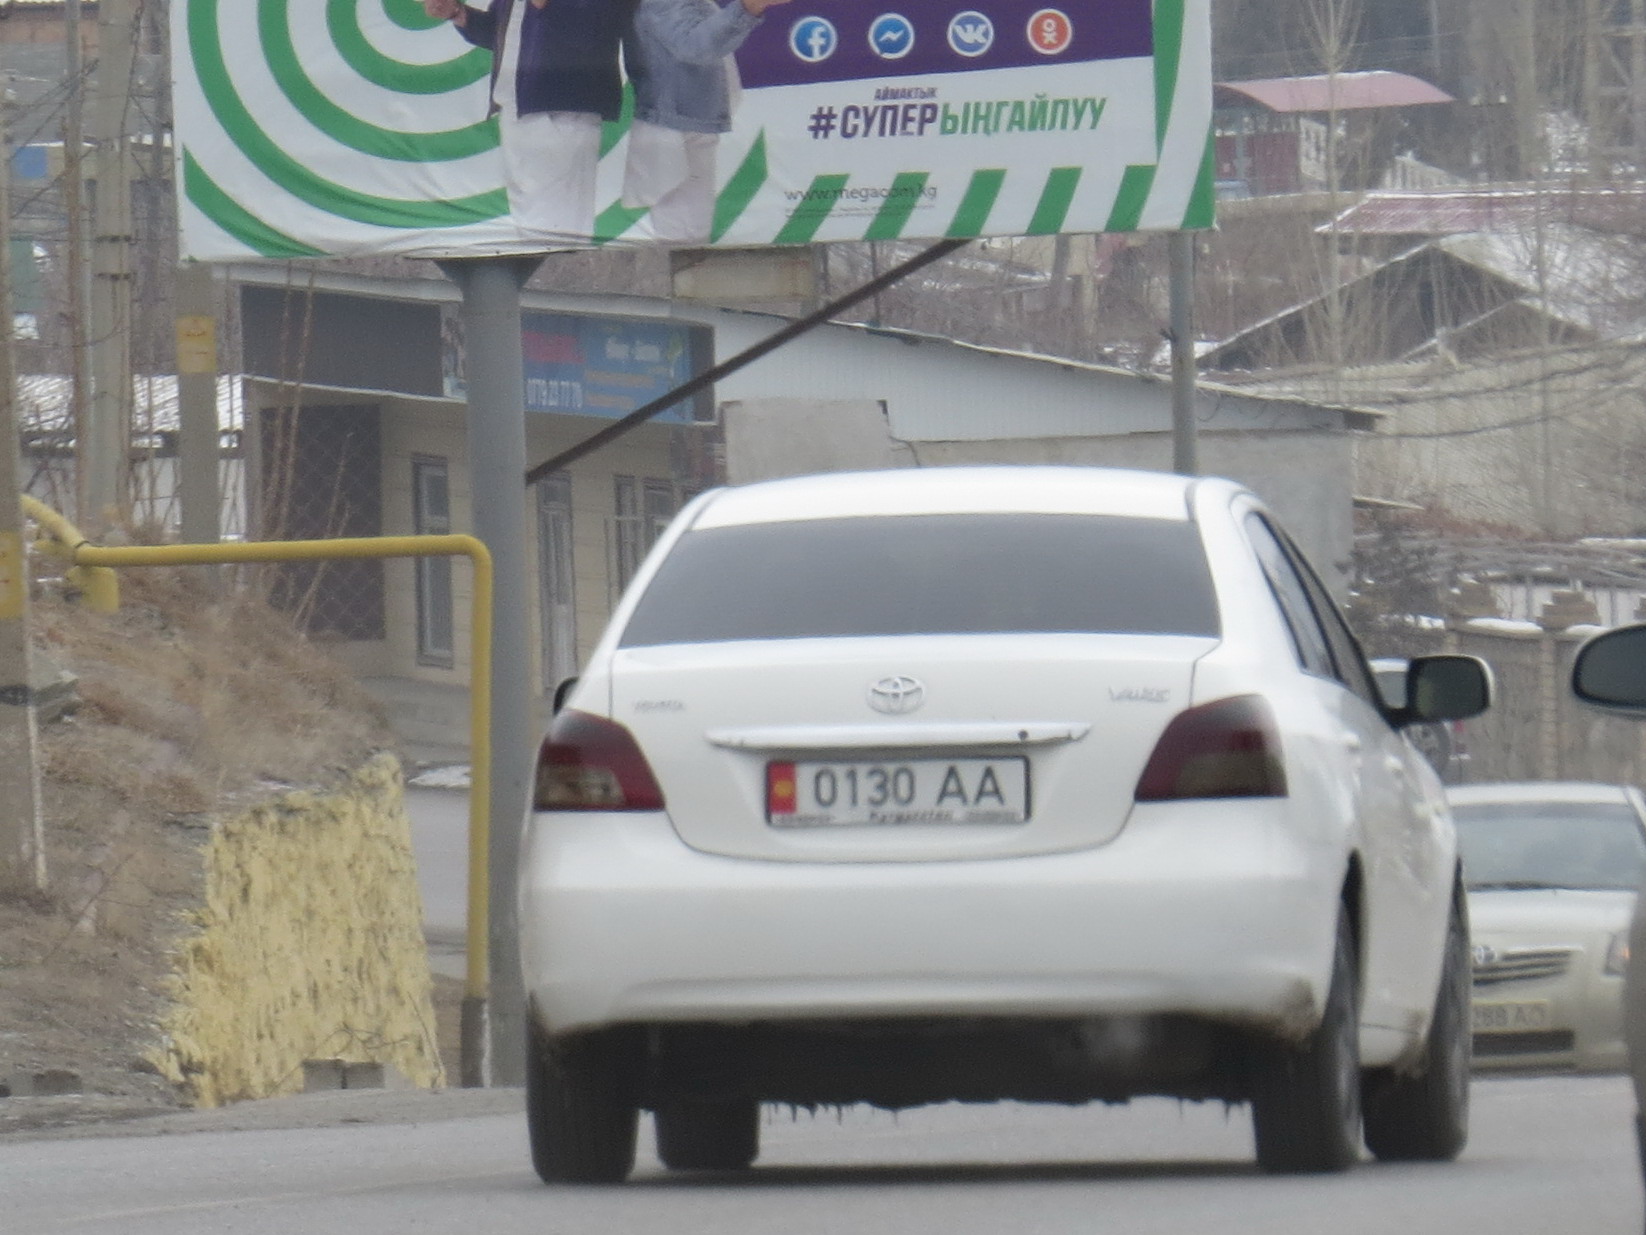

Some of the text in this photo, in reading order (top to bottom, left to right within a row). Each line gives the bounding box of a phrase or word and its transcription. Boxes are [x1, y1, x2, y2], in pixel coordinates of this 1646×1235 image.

[785, 184, 937, 205] www.megacom.kg
[813, 765, 1005, 808] 0130 AA
